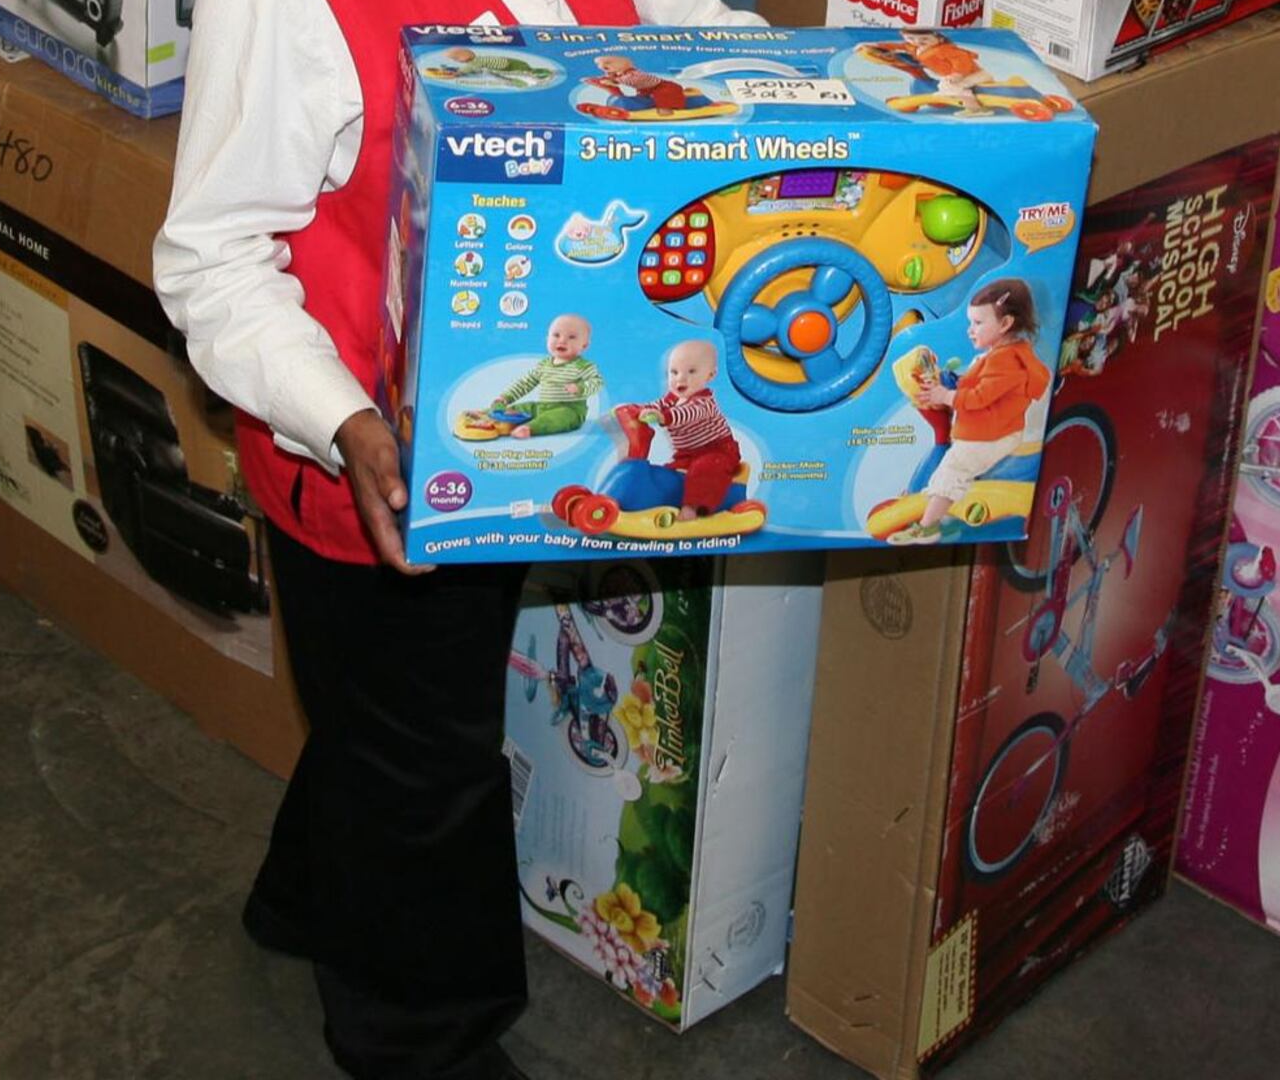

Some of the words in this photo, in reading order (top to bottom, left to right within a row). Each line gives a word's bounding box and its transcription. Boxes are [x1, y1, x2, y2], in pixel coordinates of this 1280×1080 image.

[411, 25, 503, 37] vtech
[535, 30, 607, 43] 3-in-1
[617, 30, 694, 43] Smart
[699, 30, 790, 42] Wheels
[13, 20, 60, 61] euro
[62, 49, 97, 83] pro
[448, 100, 489, 110] 6-36
[446, 130, 547, 159] vtech
[578, 135, 658, 161] 3-in-1
[666, 136, 750, 162] Smart
[754, 135, 850, 161] Wheels
[504, 158, 554, 178] Baby
[471, 192, 527, 209] Teaches
[1019, 205, 1047, 222] TRY
[1047, 203, 1070, 219] ME
[18, 230, 52, 262] HOME
[453, 240, 485, 251] Letters
[504, 242, 534, 252] Colors
[1226, 200, 1254, 275] Disney
[1191, 183, 1229, 320] HIGH
[1153, 198, 1186, 343] MUSICAL
[1171, 196, 1203, 332] SCHOOL
[449, 279, 489, 289] Numbers
[428, 481, 468, 496] 6-36
[430, 495, 466, 506] months
[424, 536, 472, 555] Grows
[475, 532, 505, 546] with
[507, 532, 541, 546] your
[543, 533, 579, 549] baby
[580, 535, 614, 550] from
[615, 537, 676, 553] crawling
[677, 539, 693, 551] to
[696, 533, 742, 551] riding!
